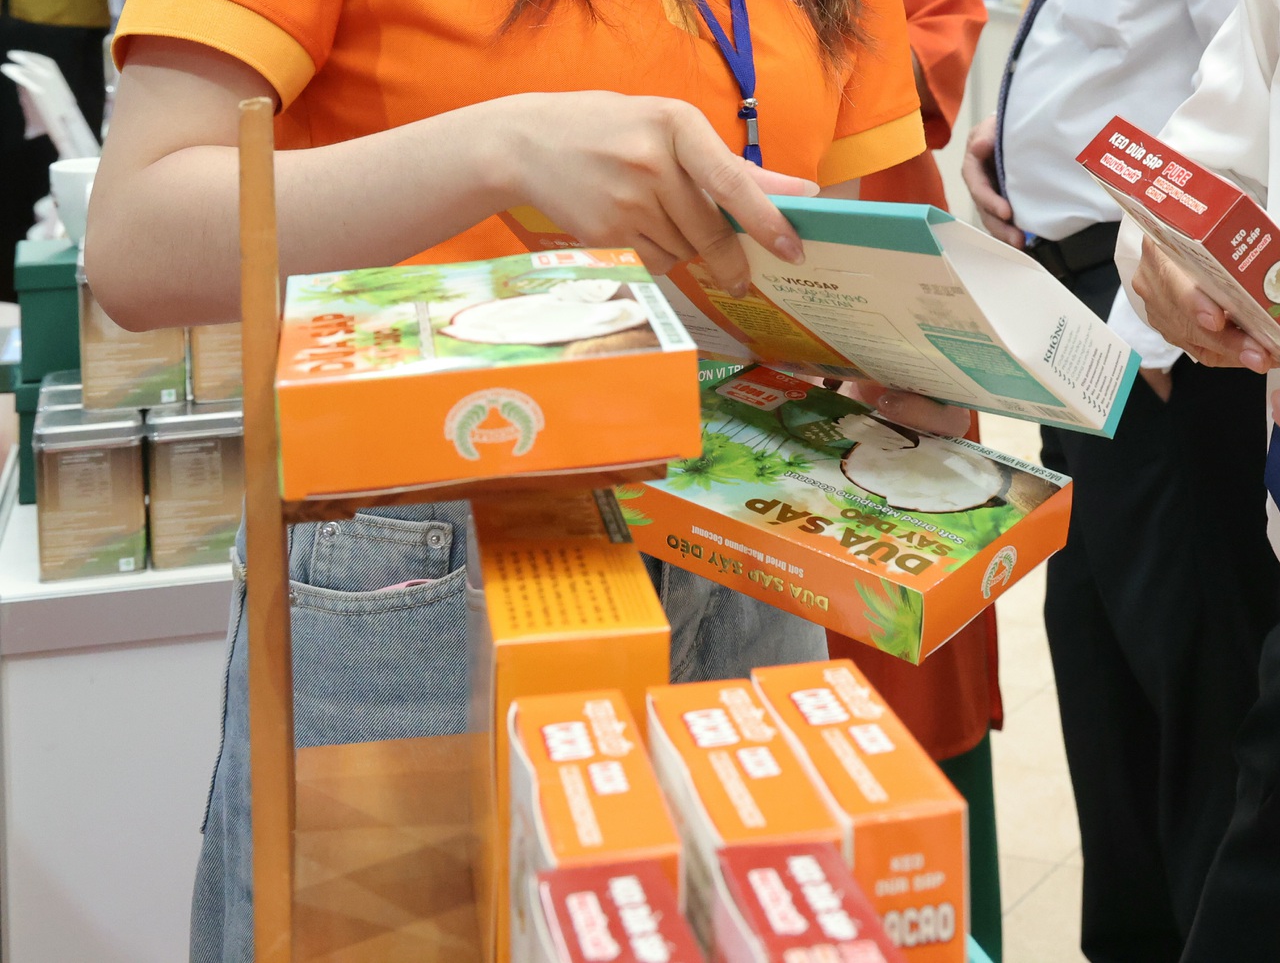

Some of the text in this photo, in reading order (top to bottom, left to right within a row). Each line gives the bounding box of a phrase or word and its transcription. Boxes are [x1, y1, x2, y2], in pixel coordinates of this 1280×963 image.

[1108, 132, 1164, 170] KẸO DỪA SÁP
[1162, 161, 1193, 187] PURE
[1145, 186, 1168, 203] CANDY
[1180, 193, 1208, 215] COCONUT
[781, 276, 839, 291] VICOSAP
[952, 438, 993, 456] SPECIALITY
[995, 453, 1015, 465] VINH
[1014, 460, 1031, 470] TRÀ
[744, 498, 834, 535] SÁP
[784, 470, 965, 545] Soft Dried Macapuno Coconut
[839, 508, 954, 557] SẤY DẺO
[691, 525, 804, 579] Soft Dried Macapuno Coconut
[839, 527, 935, 576] DỪA
[666, 534, 829, 612] DỪA SÁP SẤY DẺO
